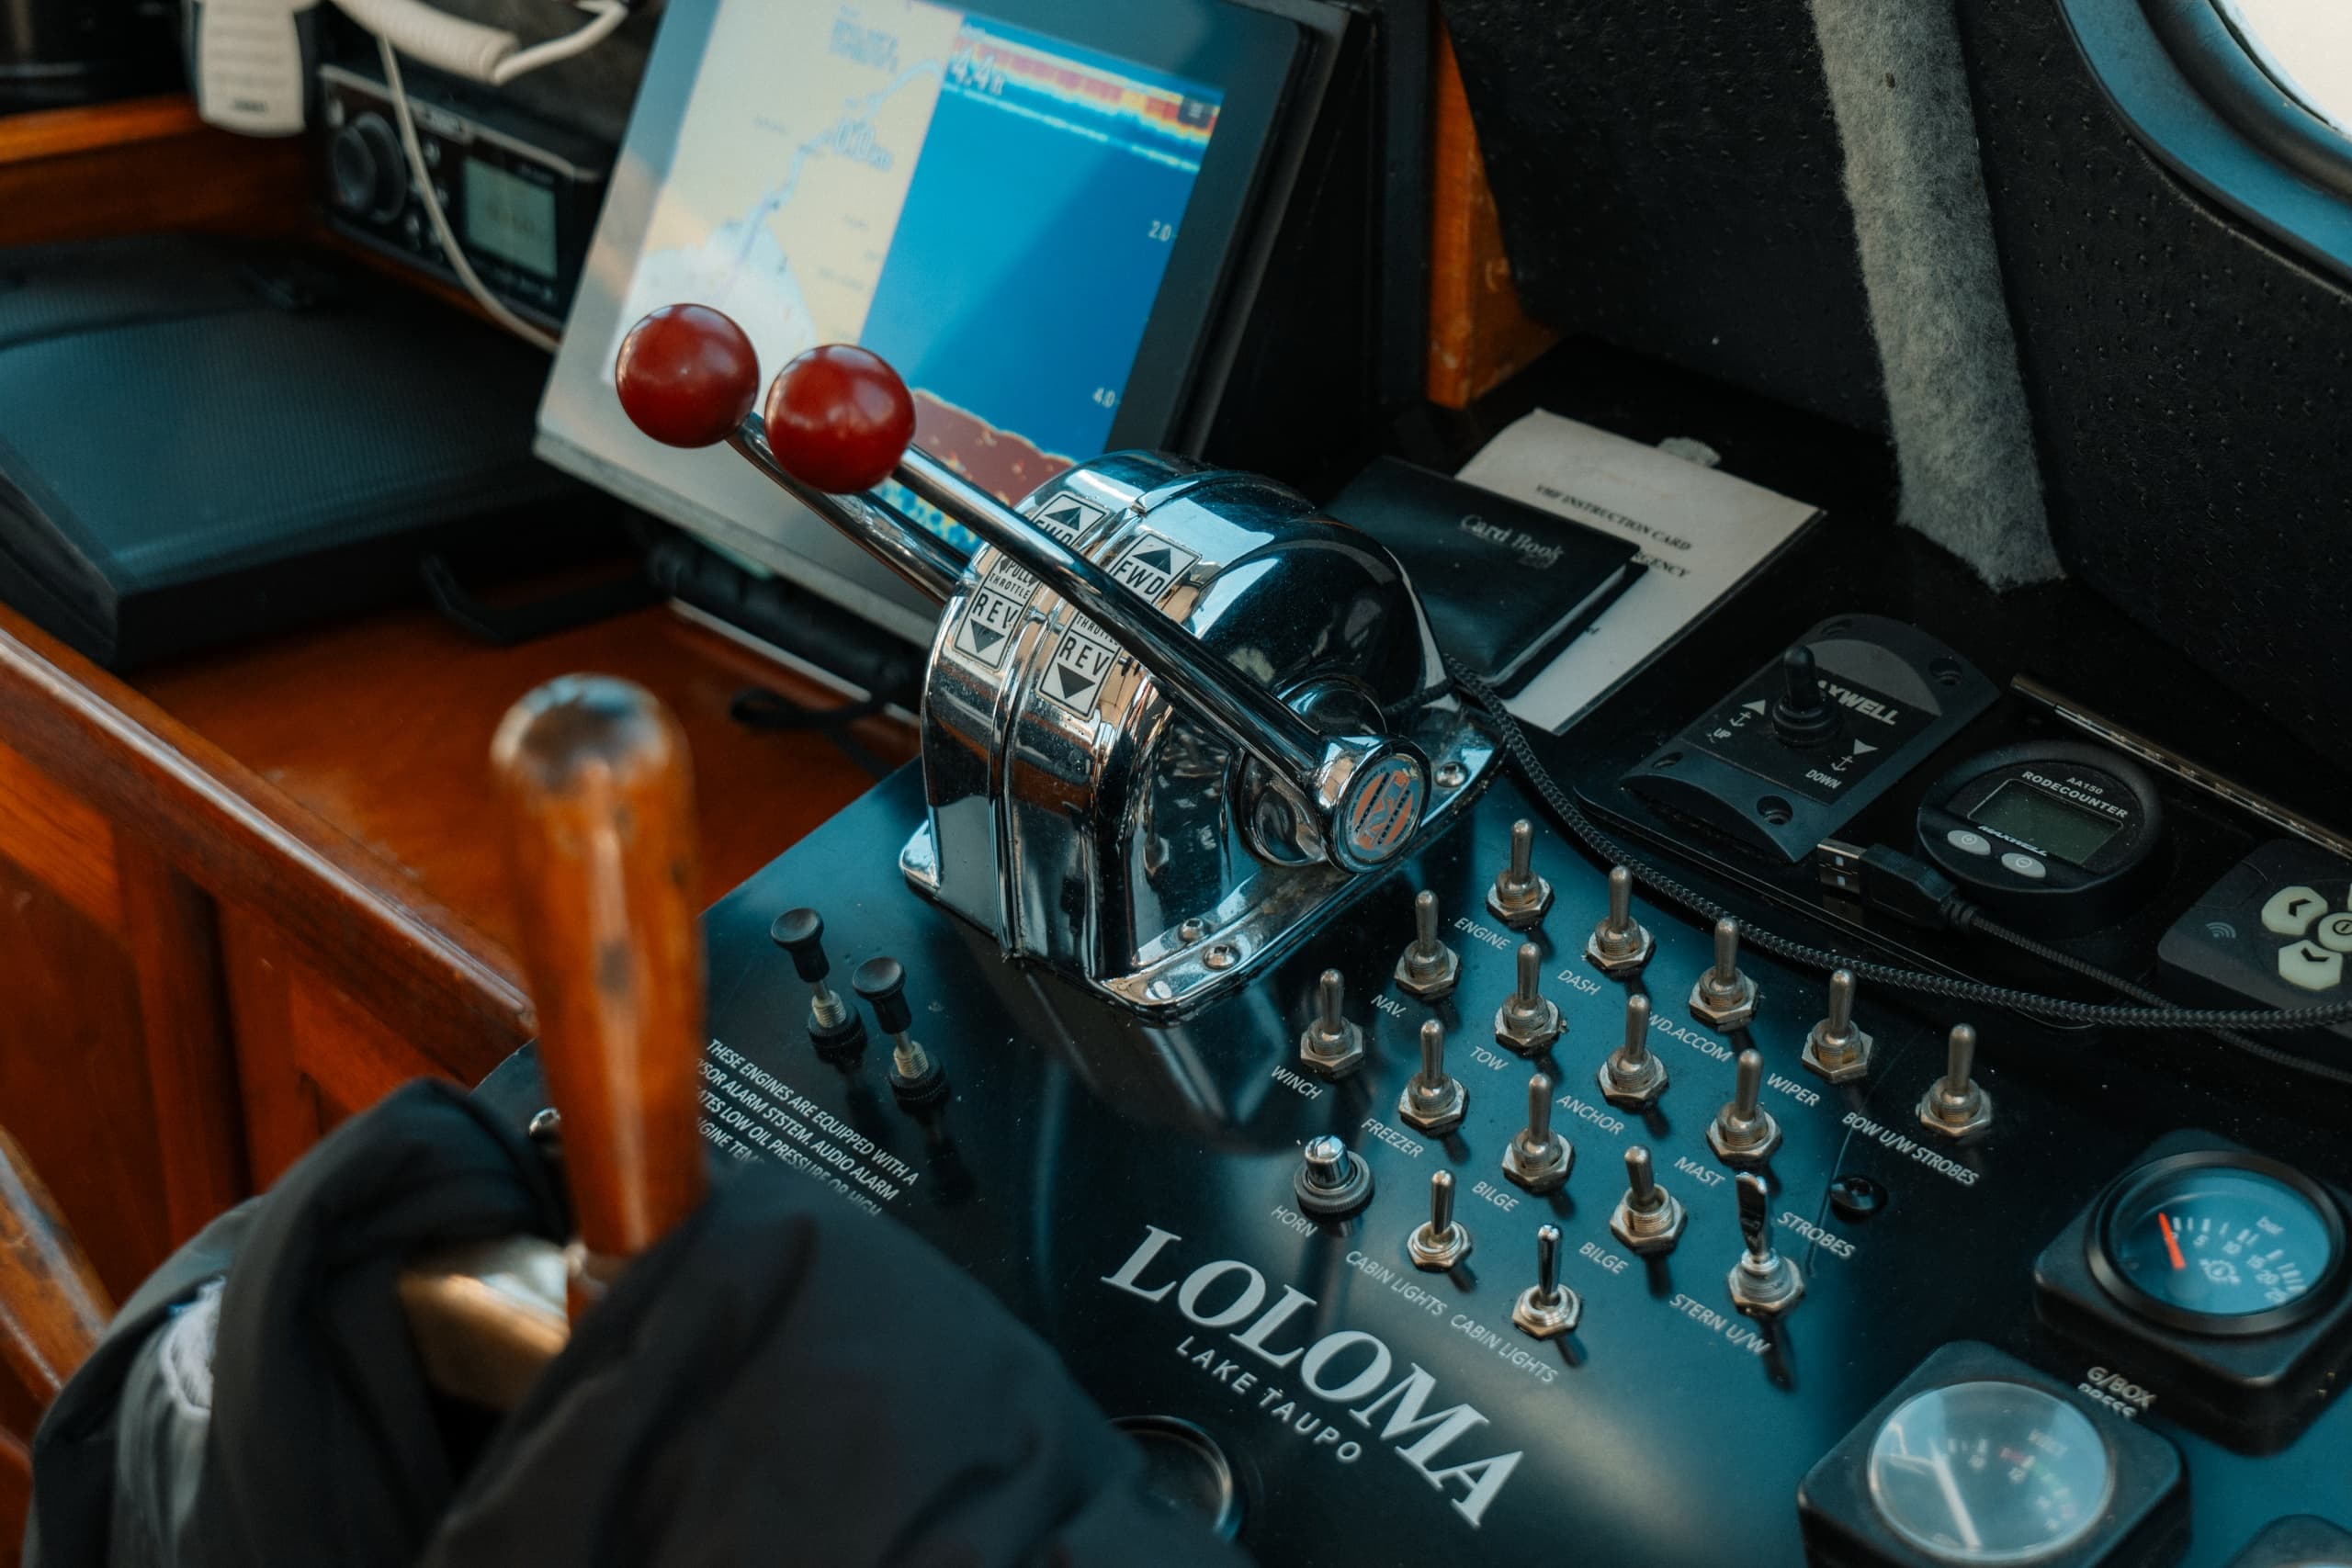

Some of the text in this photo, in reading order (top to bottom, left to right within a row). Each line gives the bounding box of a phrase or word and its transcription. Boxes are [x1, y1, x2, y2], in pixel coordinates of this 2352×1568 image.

[1148, 220, 1171, 242] 2.0
[1092, 387, 1115, 409] 4.0
[1461, 514, 1513, 543] Card
[1652, 530, 1692, 551] CARD
[989, 572, 1030, 600] THROTTLE
[1111, 559, 1166, 596] FWD
[972, 593, 1019, 629] REV
[1059, 636, 1110, 675] REV
[1713, 728, 1732, 739] UP
[1805, 769, 1841, 789] DOWN
[2021, 771, 2129, 818] RODECOUNTER
[2066, 776, 2104, 795] AA150
[1453, 917, 1510, 951] ENGINE
[1557, 969, 1602, 996] DASH
[1370, 994, 1408, 1018] NAV.
[1470, 1045, 1509, 1071] TOW
[1271, 1065, 1323, 1100] WINCH
[1766, 1072, 1820, 1108] WIPER
[707, 1039, 919, 1186] THESE ENGINES ARE EQUIPPED WITH A
[719, 1107, 754, 1131] LOW
[748, 1126, 772, 1146] OIL
[1556, 1094, 1625, 1135] ANCHOR
[720, 1081, 769, 1113] ALARM
[809, 1140, 855, 1171] AUDIO
[849, 1167, 899, 1201] ALARM
[1361, 1117, 1424, 1158] FREEZER
[1842, 1111, 1980, 1185] BOW U/W STROBES
[1674, 1156, 1725, 1187] MAST
[1471, 1180, 1520, 1213] BILGE
[1271, 1204, 1318, 1238] HORN
[1778, 1212, 1857, 1260] STROBES
[1578, 1242, 1629, 1274] BILGE
[1346, 1250, 1448, 1316] CABIN LIGHTS
[1669, 1293, 1771, 1356] STERN U/W
[1450, 1314, 1558, 1383] CABIN LIGHTS
[1101, 1224, 1524, 1529] LOLOMA
[2086, 1366, 2156, 1411] G/BOX
[1176, 1336, 1363, 1463] LAKE TAUPO
